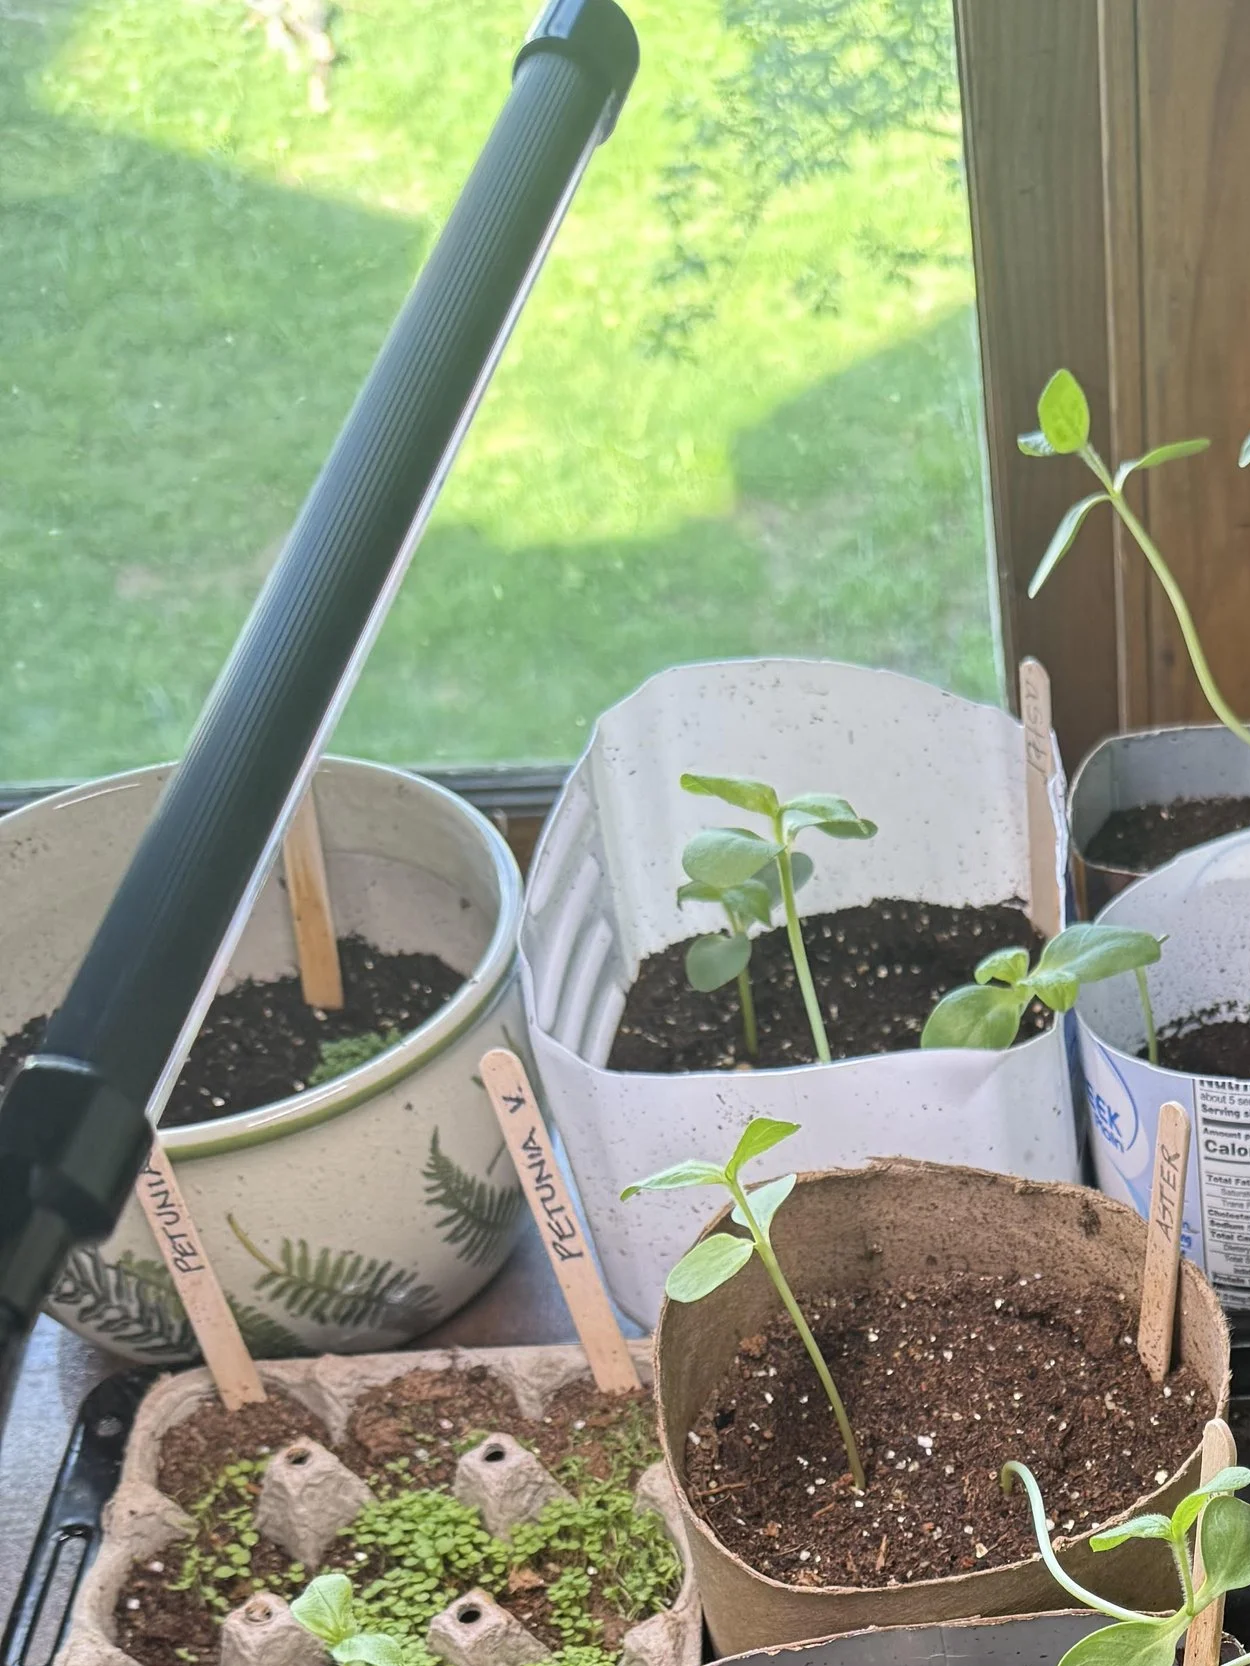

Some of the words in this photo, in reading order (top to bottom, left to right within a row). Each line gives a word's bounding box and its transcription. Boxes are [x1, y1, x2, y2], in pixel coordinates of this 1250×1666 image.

[1200, 1092, 1226, 1105] about
[1229, 1095, 1235, 1105] 5
[1201, 1104, 1241, 1119] Serving
[1203, 1127, 1242, 1139] Amount
[1206, 1174, 1233, 1185] Total
[1234, 1178, 1250, 1186] Fat
[522, 1126, 584, 1261] PETUNIA
[1155, 1143, 1181, 1243] ASTER
[1222, 1200, 1245, 1209] Trans
[1209, 1219, 1244, 1231] Sodium
[1210, 1230, 1234, 1241] Total
